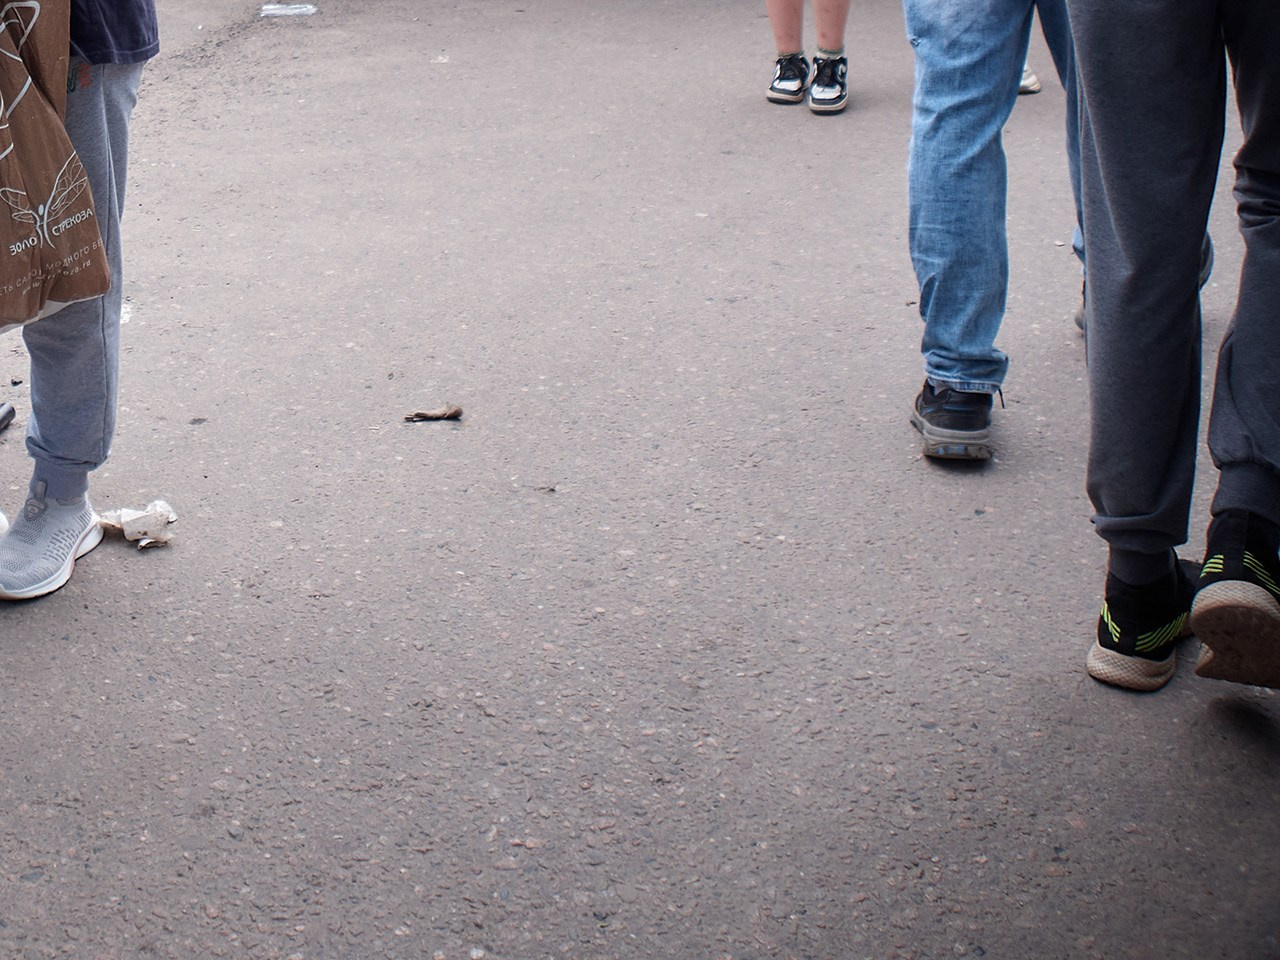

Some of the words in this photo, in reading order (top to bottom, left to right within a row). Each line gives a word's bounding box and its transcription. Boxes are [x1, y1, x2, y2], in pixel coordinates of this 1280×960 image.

[9, 236, 38, 256] ЗОЛО
[51, 208, 94, 236] СТРЕКОЗА
[45, 246, 90, 272] МОДНОГО
